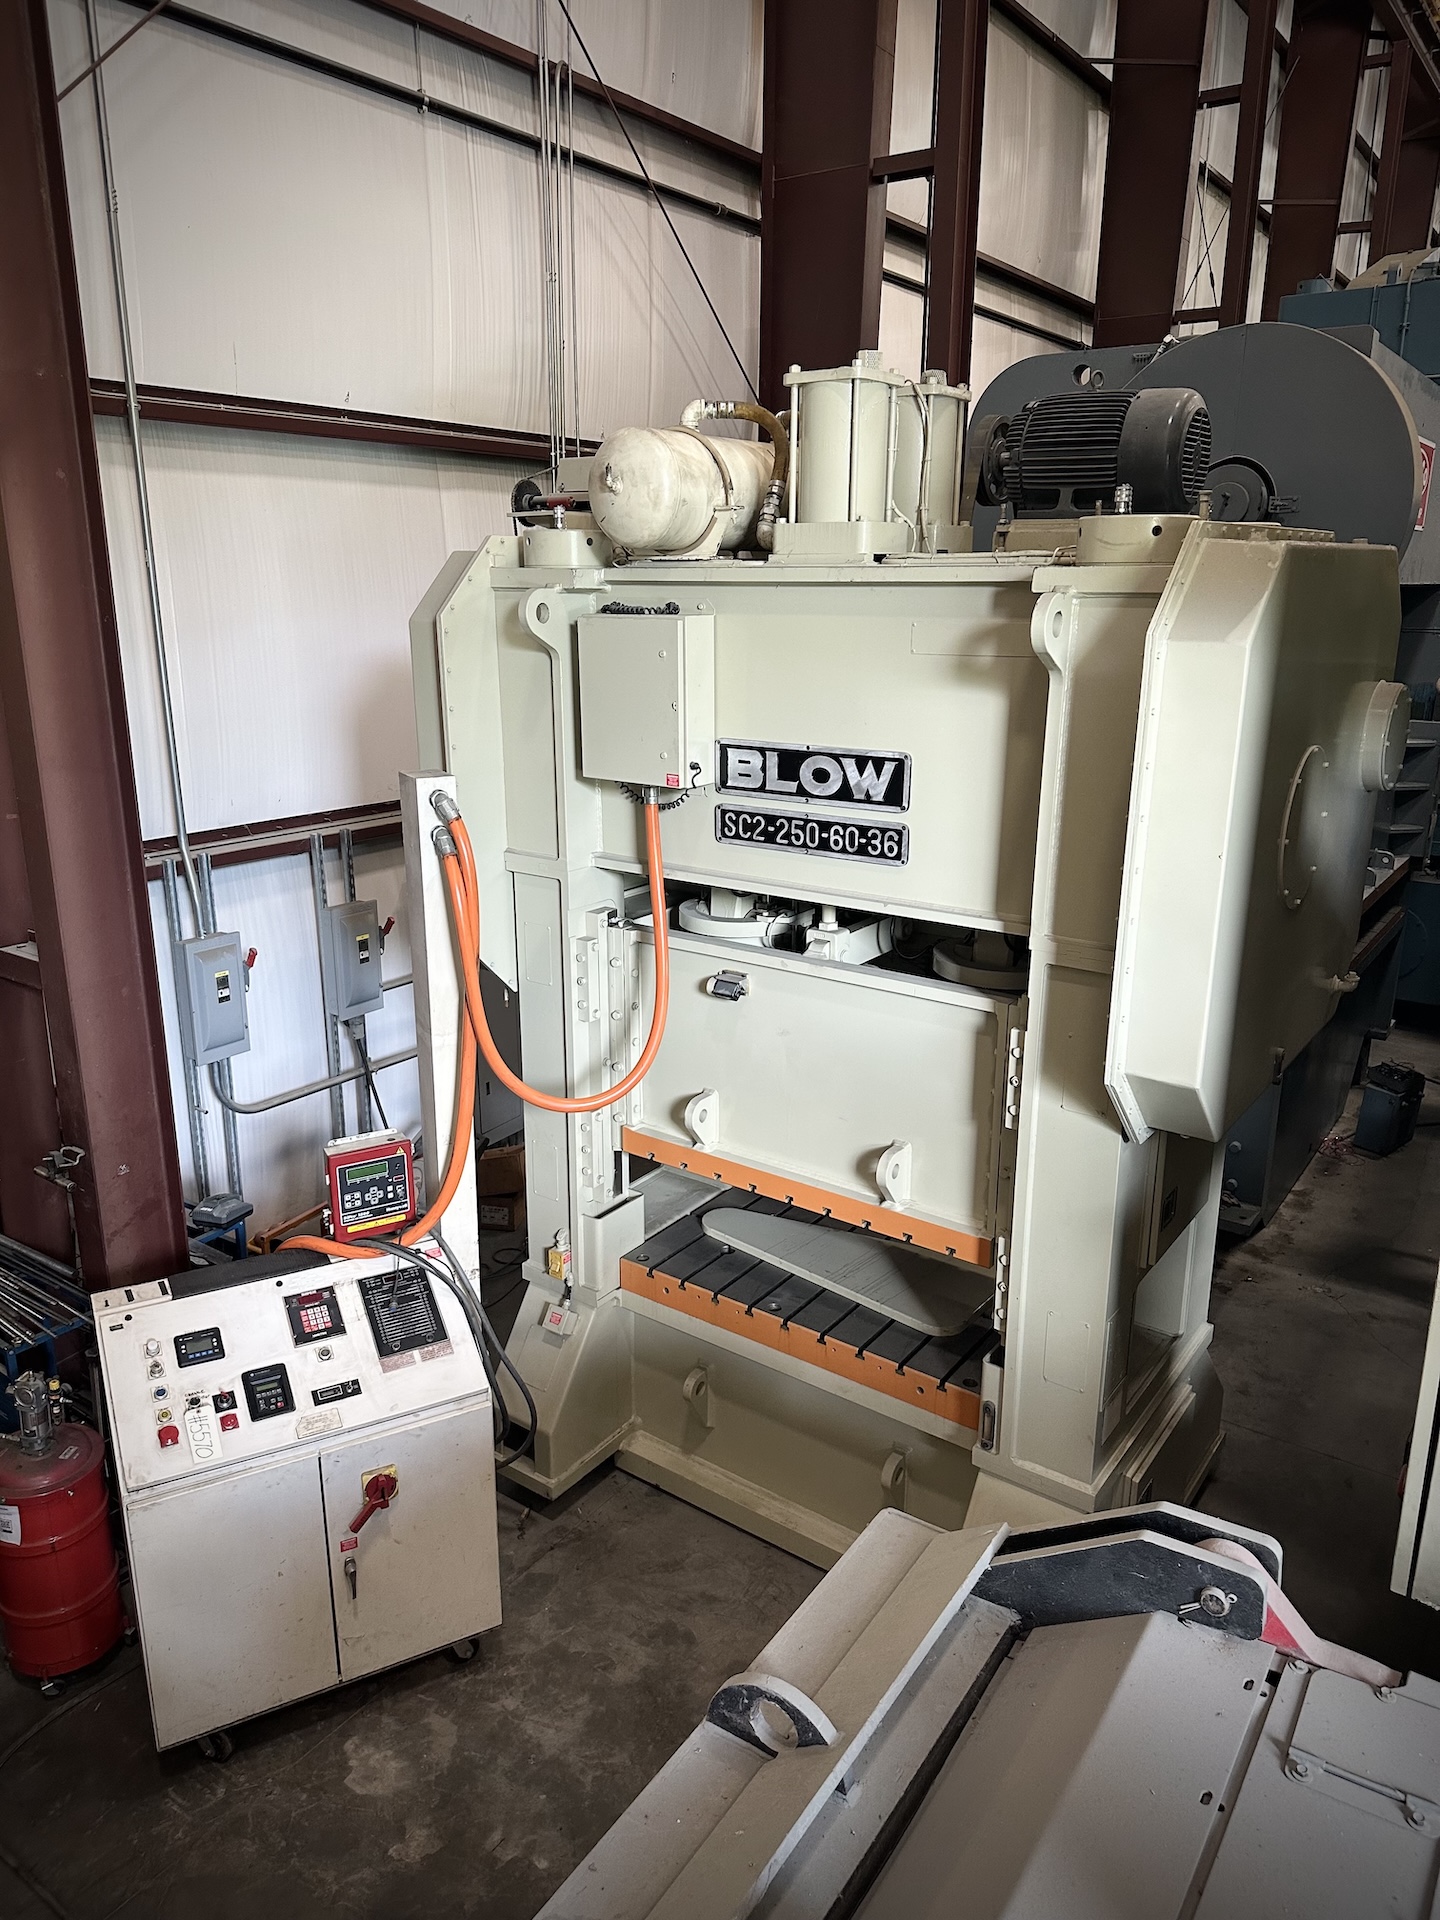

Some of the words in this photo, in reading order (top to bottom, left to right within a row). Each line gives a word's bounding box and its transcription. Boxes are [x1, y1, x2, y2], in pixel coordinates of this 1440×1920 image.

[726, 748, 899, 802] BLOW
[724, 811, 900, 858] SC2-250-60-36
[187, 1415, 214, 1459] #5570
